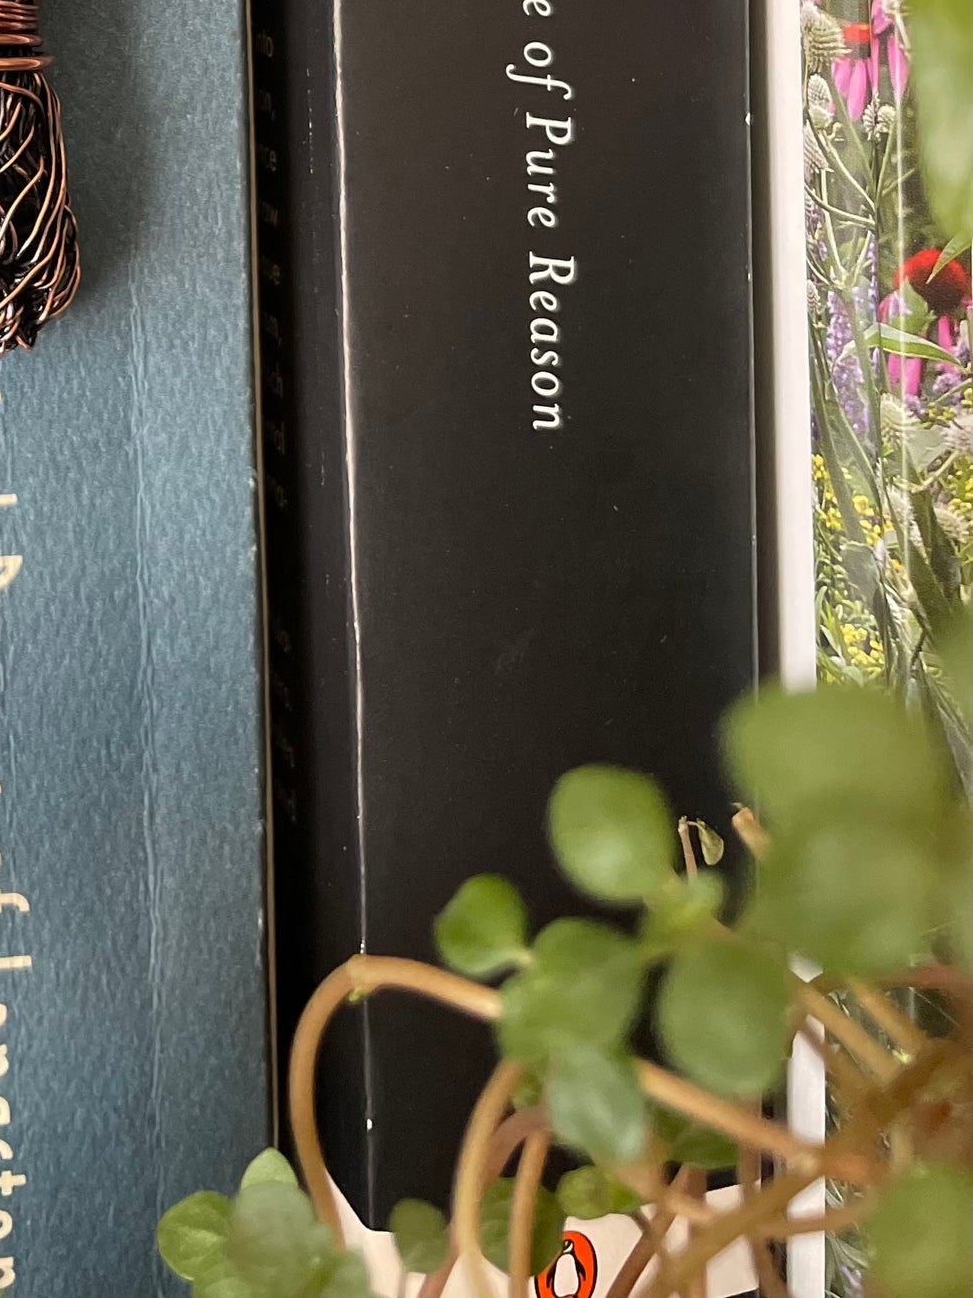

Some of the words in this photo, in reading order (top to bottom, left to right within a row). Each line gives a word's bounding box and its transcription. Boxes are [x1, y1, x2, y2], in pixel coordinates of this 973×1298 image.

[506, 40, 572, 100] of
[525, 110, 575, 227] Pure
[528, 251, 576, 430] Reason
